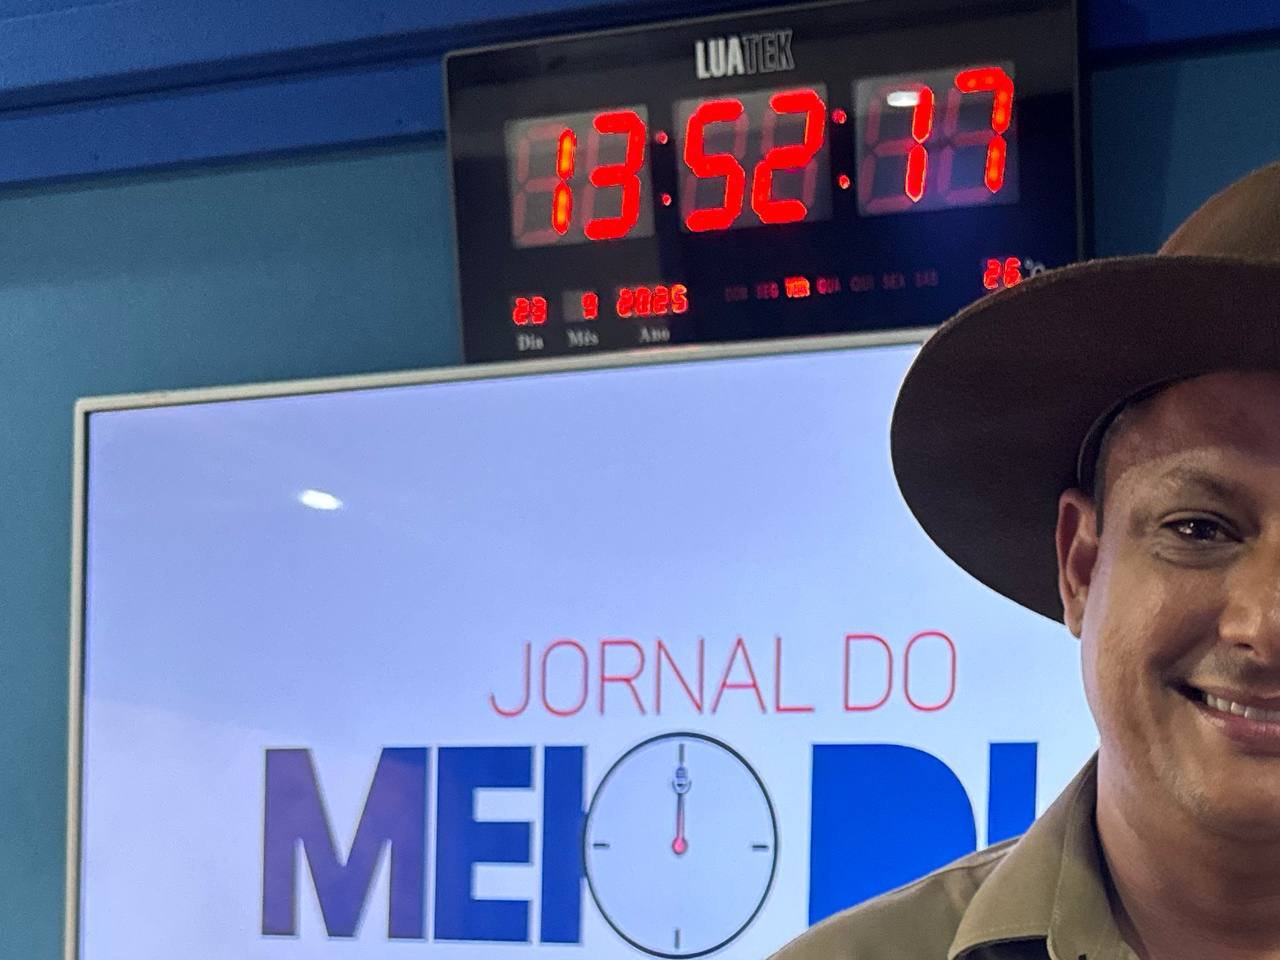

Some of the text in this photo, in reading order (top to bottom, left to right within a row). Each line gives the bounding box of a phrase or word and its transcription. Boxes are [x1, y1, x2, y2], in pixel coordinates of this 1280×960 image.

[695, 27, 796, 79] LUATEK
[513, 297, 547, 326] 23
[582, 293, 598, 320] 9
[616, 284, 688, 318] 2025
[517, 333, 544, 350] Dia
[639, 326, 670, 343] Ano
[488, 630, 958, 718] JORNAL DO
